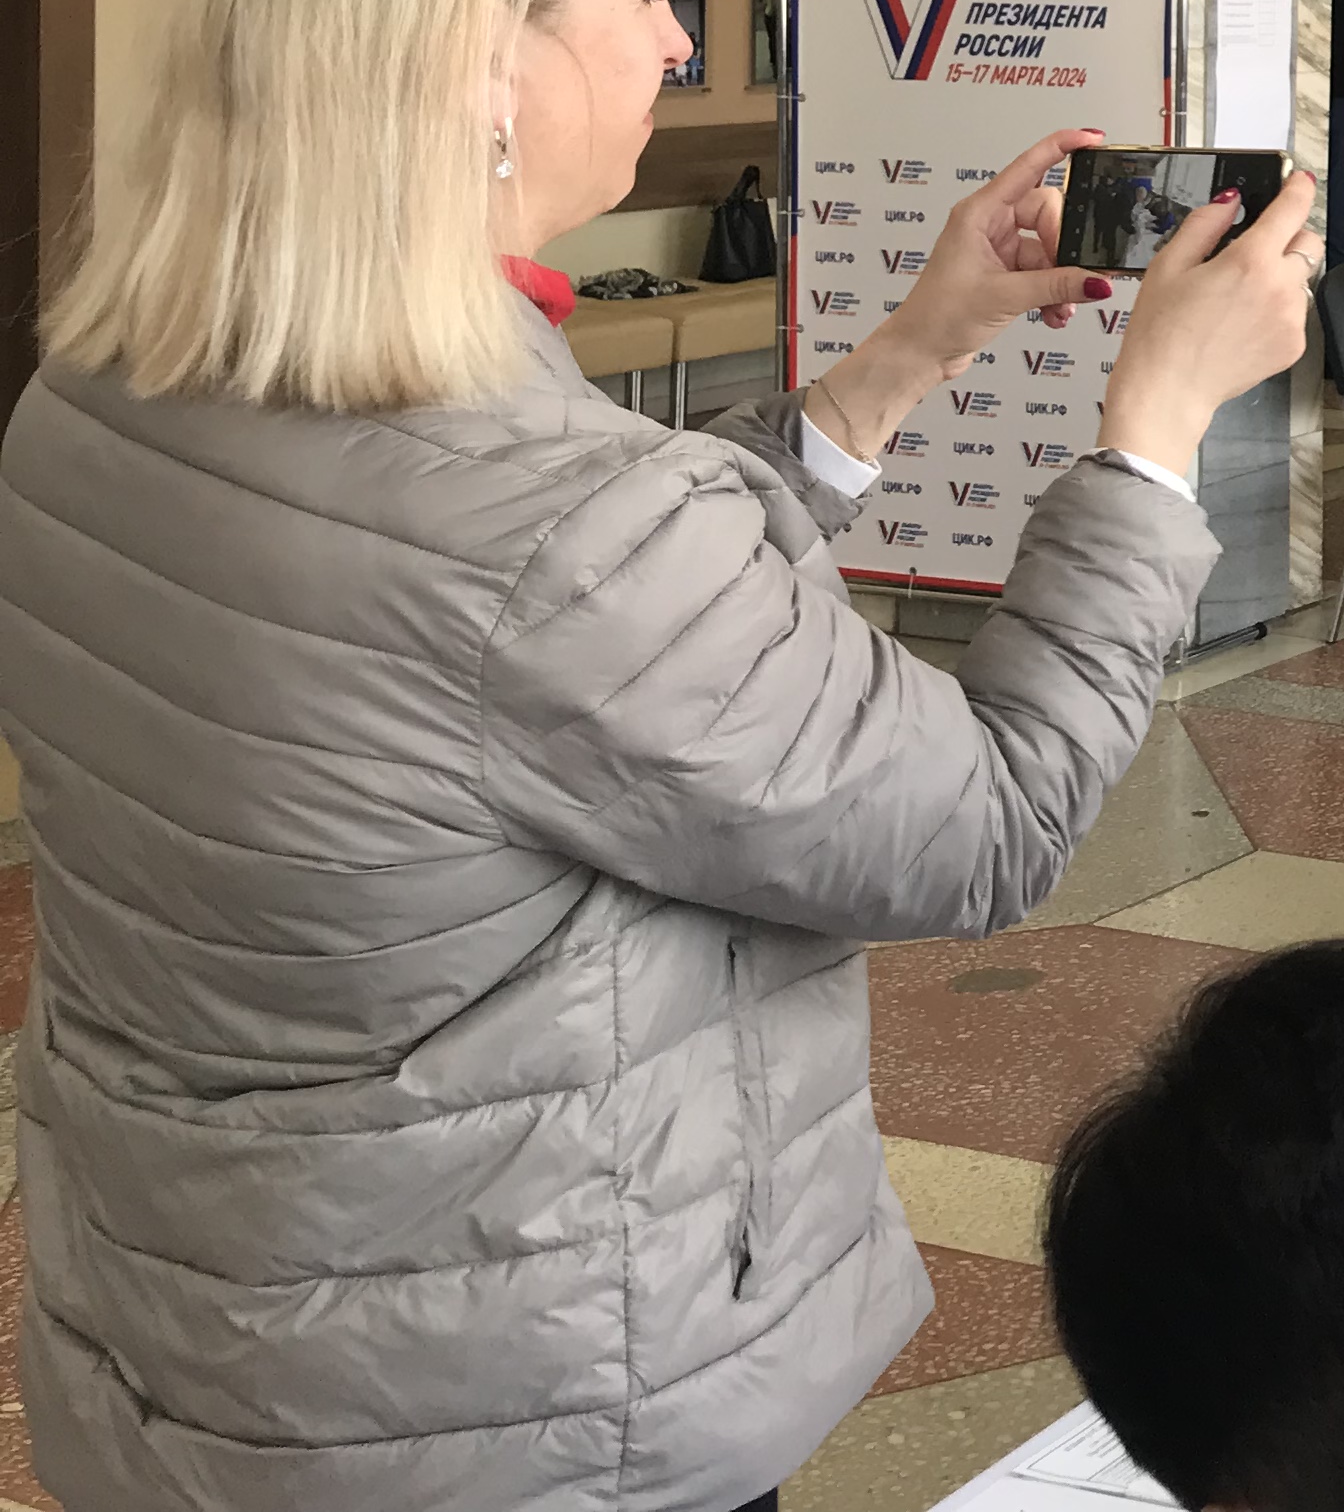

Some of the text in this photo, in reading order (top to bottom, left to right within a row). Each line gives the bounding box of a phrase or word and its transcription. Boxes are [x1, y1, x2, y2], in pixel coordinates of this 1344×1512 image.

[964, 2, 1108, 30] ПРЕЗИДЕНТА
[953, 33, 1046, 59] РОССИИ
[991, 66, 1045, 87] МАРТА
[1046, 67, 1087, 88] 2024
[815, 161, 855, 174] ЦИК.РФ
[885, 210, 925, 223] ЦИК.РФ
[815, 250, 855, 264] ЦИК.РФ
[815, 341, 853, 353] ЦИК.РФ
[1026, 402, 1067, 416] ЦИК.РФ
[954, 442, 994, 456] ЦИК.РФ
[882, 481, 922, 495] ЦИК.РФ
[952, 533, 993, 547] ЦИК.РФ
